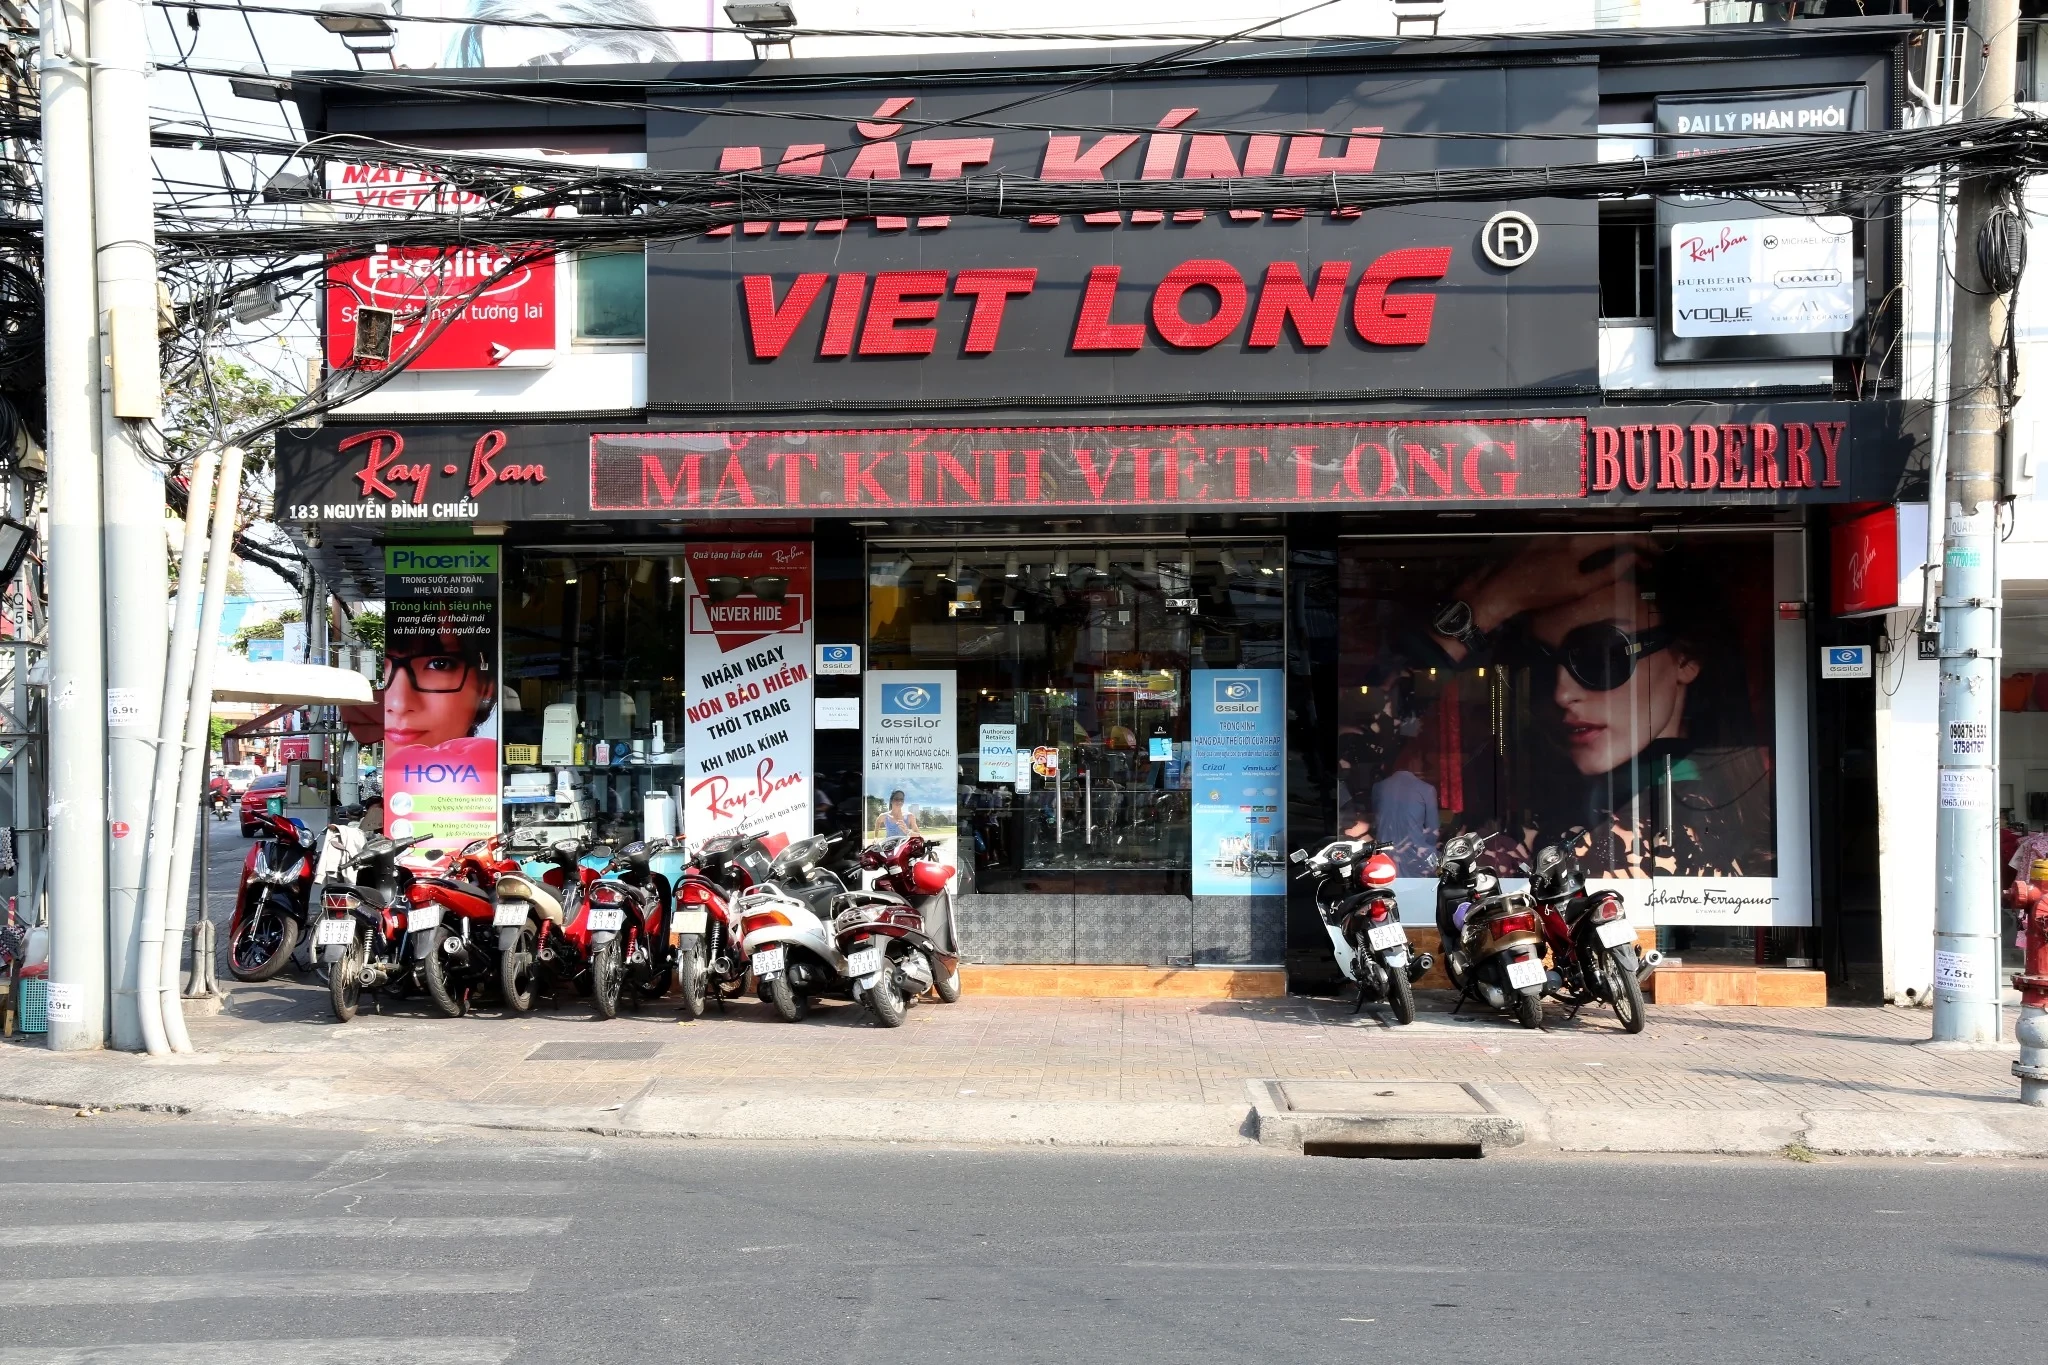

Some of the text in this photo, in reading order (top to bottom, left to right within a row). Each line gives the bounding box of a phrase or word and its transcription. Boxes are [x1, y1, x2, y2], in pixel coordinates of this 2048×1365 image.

[1715, 111, 1737, 132] LÝ
[1742, 109, 1794, 131] PHÂN
[1799, 104, 1845, 128] PHỐI
[1781, 237, 1818, 246] MICHAEL
[1822, 236, 1846, 244] KORS
[1677, 276, 1753, 286] BURBERRY
[1780, 274, 1835, 284] COACH
[743, 246, 1453, 358] VIET LONG
[472, 304, 518, 323] tương
[524, 303, 542, 320] lai
[1591, 421, 1847, 492] BURBERRY
[1289, 440, 1523, 499] LONG
[289, 496, 479, 520] 183 NGUYỄN ĐÌNH CHIỂU
[401, 576, 427, 584] TRONG
[450, 576, 461, 584] AN
[433, 585, 442, 594] VÀ
[460, 586, 473, 594] DAI
[390, 600, 492, 613] Tròng kính siêu nhẹ
[397, 615, 420, 625] mang
[421, 613, 436, 623] đến
[469, 613, 485, 623] mái
[710, 606, 782, 622] NEVER HIDE
[393, 625, 491, 637] và hài lòng cho người đeo
[701, 645, 785, 690] NHẬN NGAY
[686, 662, 808, 724] NÓN BẢO HIỂM
[1215, 703, 1260, 713] essilor
[706, 698, 791, 740] THỜI TRANG
[881, 716, 942, 729] essilor
[701, 729, 789, 773] KHI MUA KÍNH
[981, 746, 1013, 755] HOYA
[402, 764, 480, 783] HOYA
[1202, 763, 1226, 771] Crizal
[754, 816, 764, 826] khi
[1644, 888, 1779, 914] Salvatore Ferragamo
